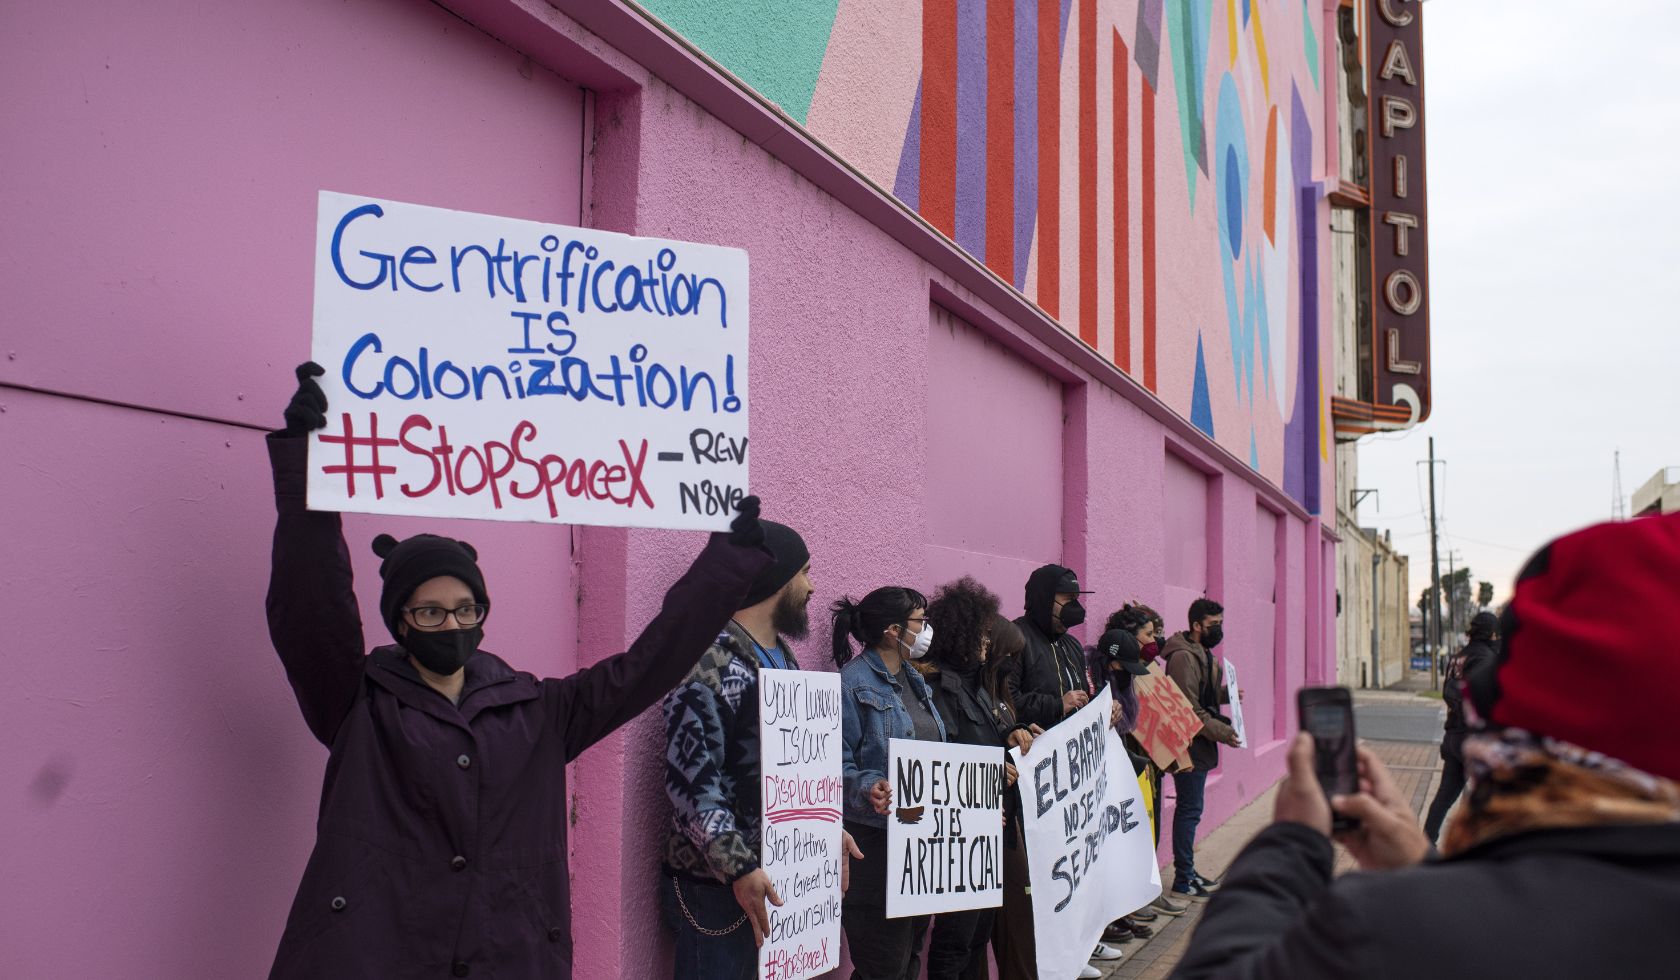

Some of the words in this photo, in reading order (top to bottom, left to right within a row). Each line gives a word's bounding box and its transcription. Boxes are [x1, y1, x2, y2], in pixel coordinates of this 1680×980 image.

[1379, 0, 1422, 375] CAPITOL
[331, 204, 728, 328] Gentrification
[508, 311, 577, 355] IS
[342, 333, 742, 413] Colonization!
[318, 412, 655, 518] #StopSpaceX
[897, 757, 924, 807] NO
[932, 761, 951, 806] ES
[1034, 749, 1069, 819] EL
[933, 808, 944, 837] SI
[950, 808, 962, 837] ES
[1063, 803, 1079, 837] NO
[1080, 790, 1094, 830] SE
[766, 825, 790, 866] Stop
[900, 835, 1003, 895] ARTIFICIAL
[1052, 849, 1080, 912] SE
[770, 894, 841, 944] Brownsville
